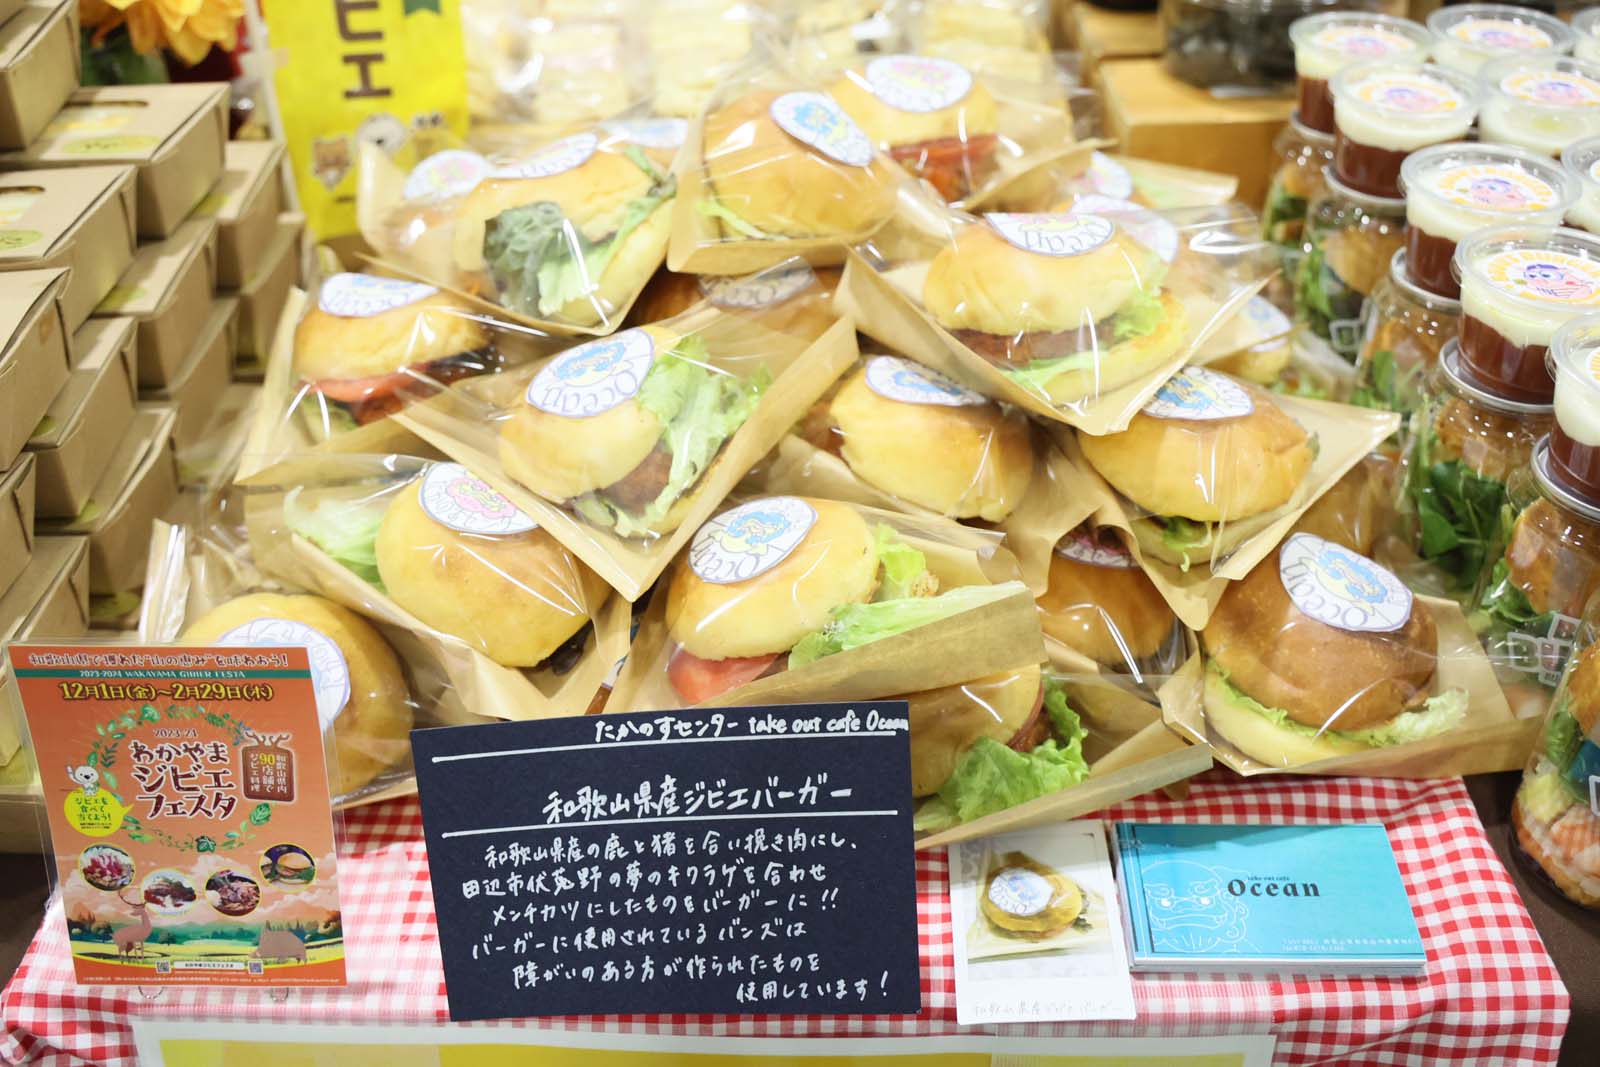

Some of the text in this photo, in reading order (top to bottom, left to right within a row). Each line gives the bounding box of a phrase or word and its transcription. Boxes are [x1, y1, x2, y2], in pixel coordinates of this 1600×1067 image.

[595, 713, 738, 742] たかのすセンター
[749, 714, 787, 734] take
[792, 717, 821, 733] out
[826, 709, 860, 734] cafe
[130, 742, 229, 763] わかやま
[133, 764, 235, 793] ジビエ
[137, 792, 237, 820] フェスタ
[542, 773, 852, 825] 和歌山県産ジビエバーガー
[1227, 878, 1320, 896] Ocean
[473, 922, 807, 960] バーガーに使用されているバンズは
[513, 953, 820, 990] 障がいのある方が作られたものを
